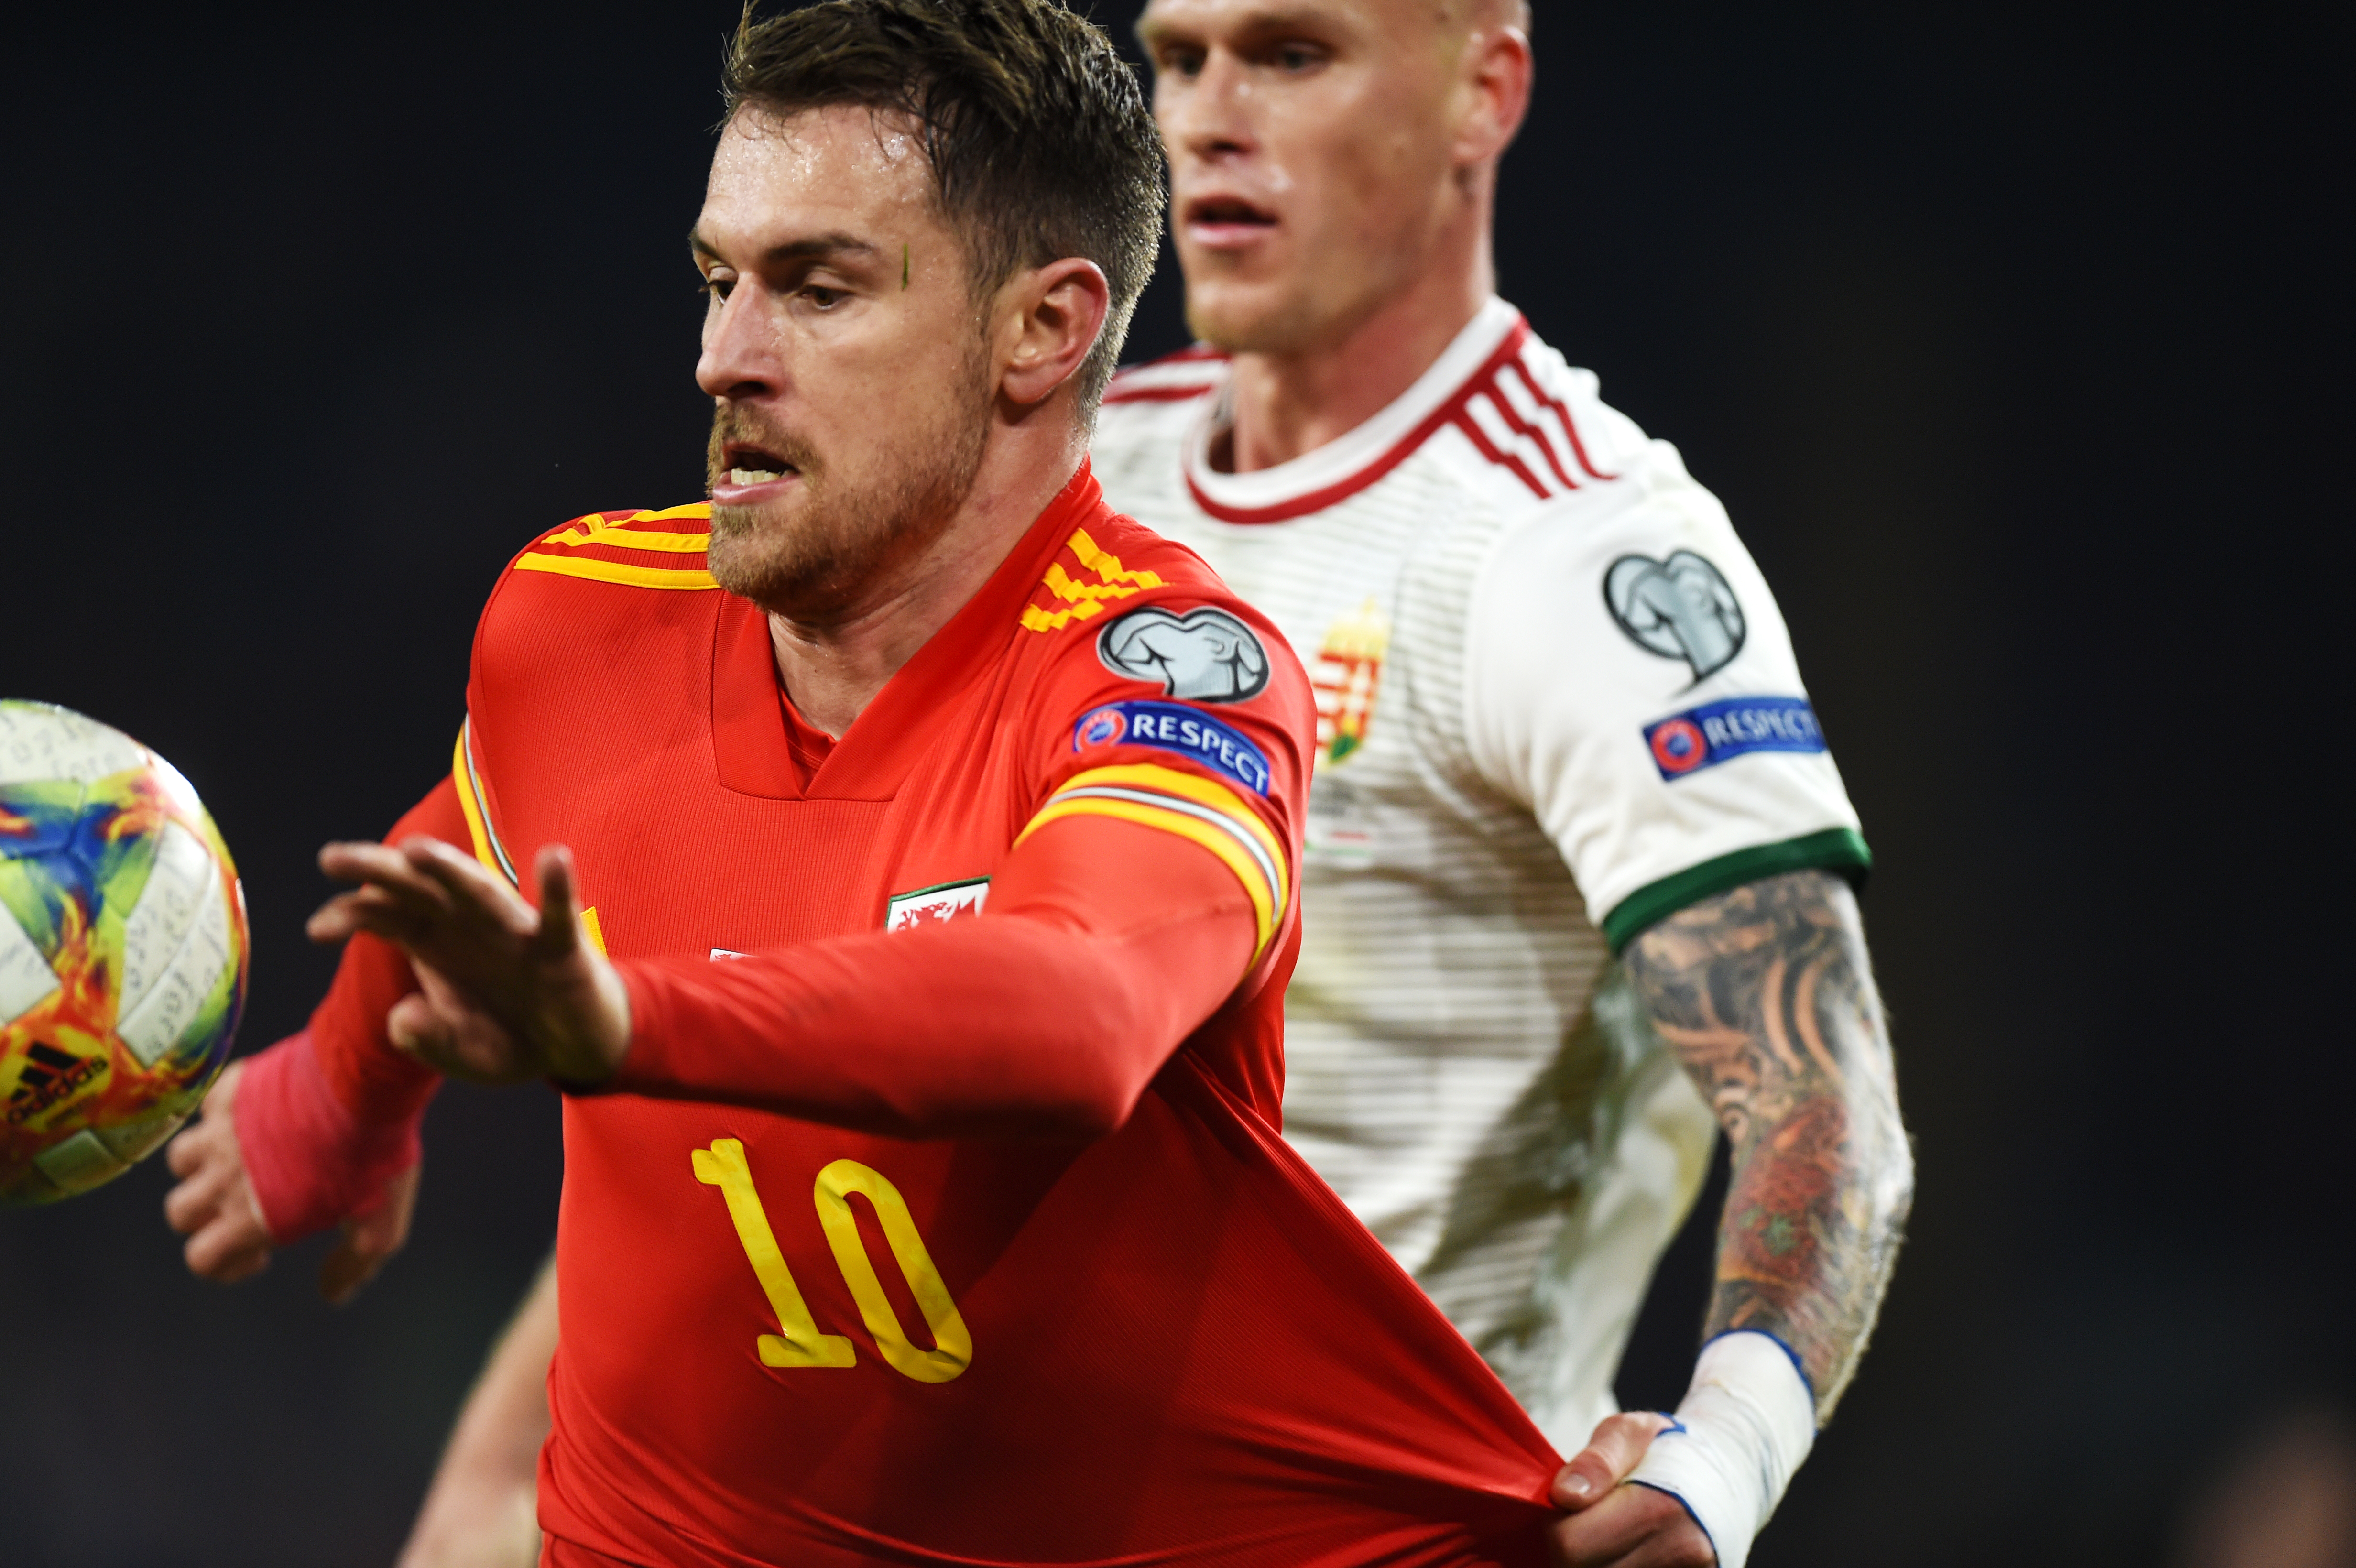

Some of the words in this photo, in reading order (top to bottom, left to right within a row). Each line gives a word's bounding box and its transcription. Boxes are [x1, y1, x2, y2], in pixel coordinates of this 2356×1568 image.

[1133, 713, 1267, 792] RESPECT
[8, 1055, 108, 1123] adidas
[691, 1138, 972, 1383] 10
